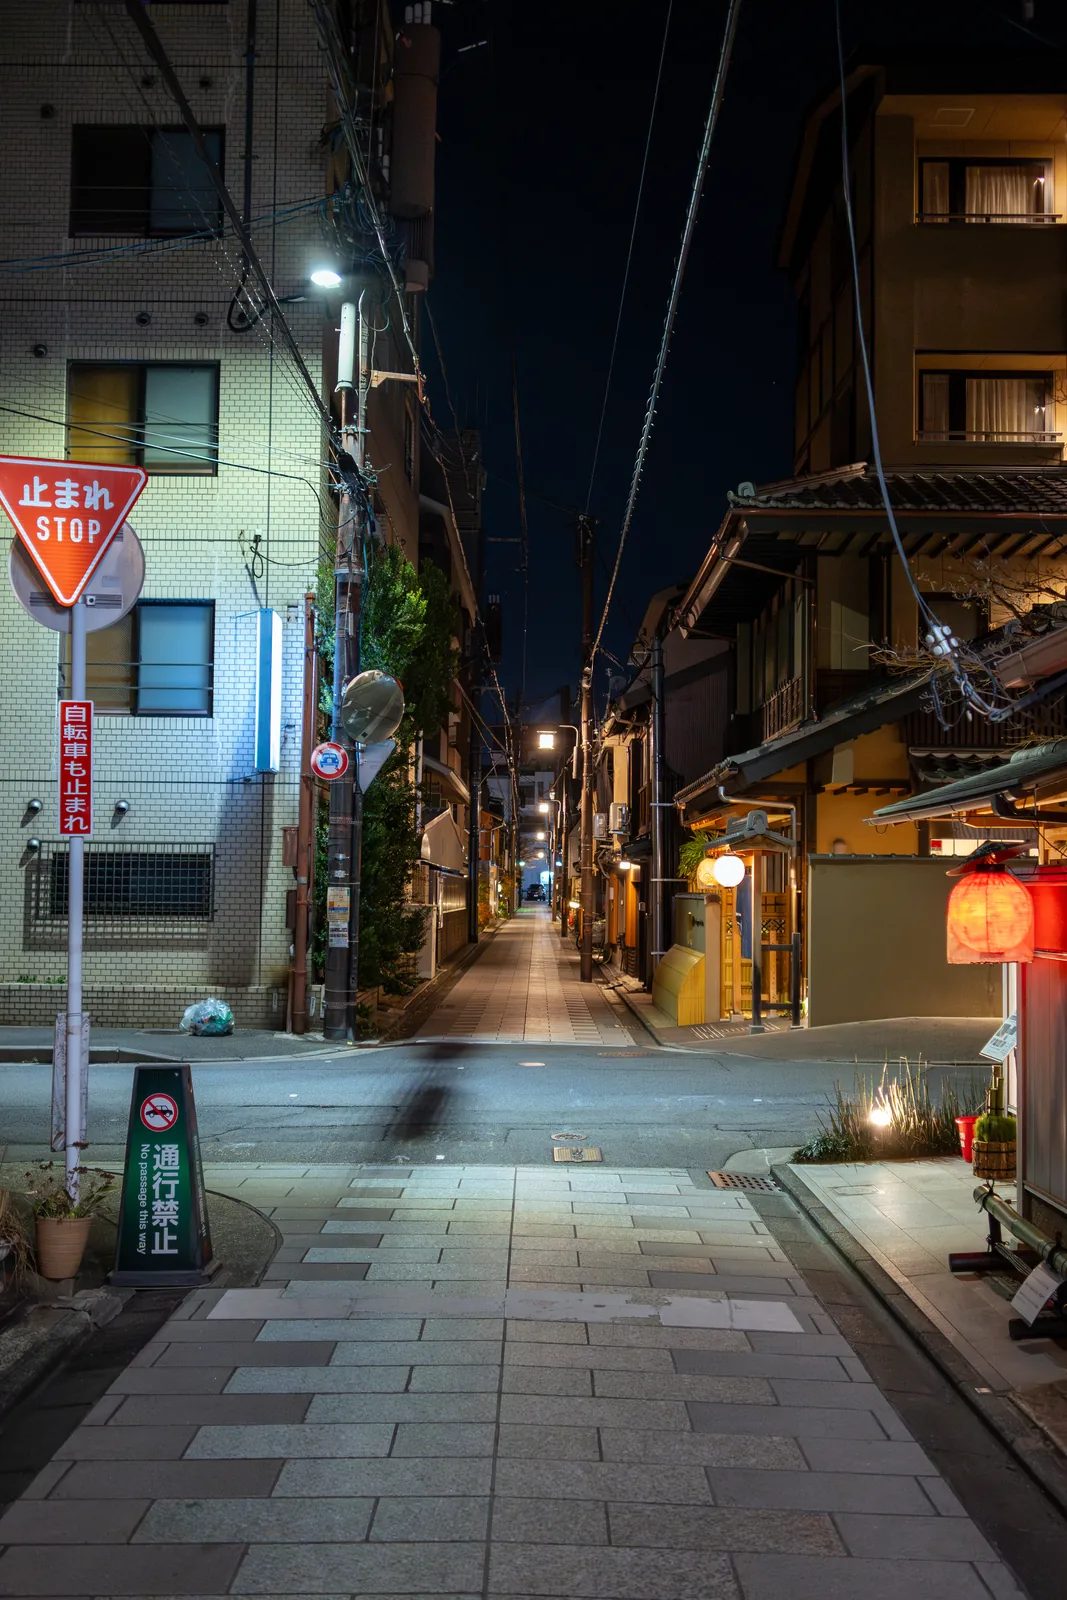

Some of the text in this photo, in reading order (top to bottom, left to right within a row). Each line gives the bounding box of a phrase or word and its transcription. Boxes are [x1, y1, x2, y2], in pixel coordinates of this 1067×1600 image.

[18, 475, 115, 511] 止まれ
[36, 516, 101, 544] STOP
[63, 705, 89, 831] 自転車も止まれ
[136, 1144, 150, 1255] No passage this way
[151, 1143, 180, 1255] 通行禁止
